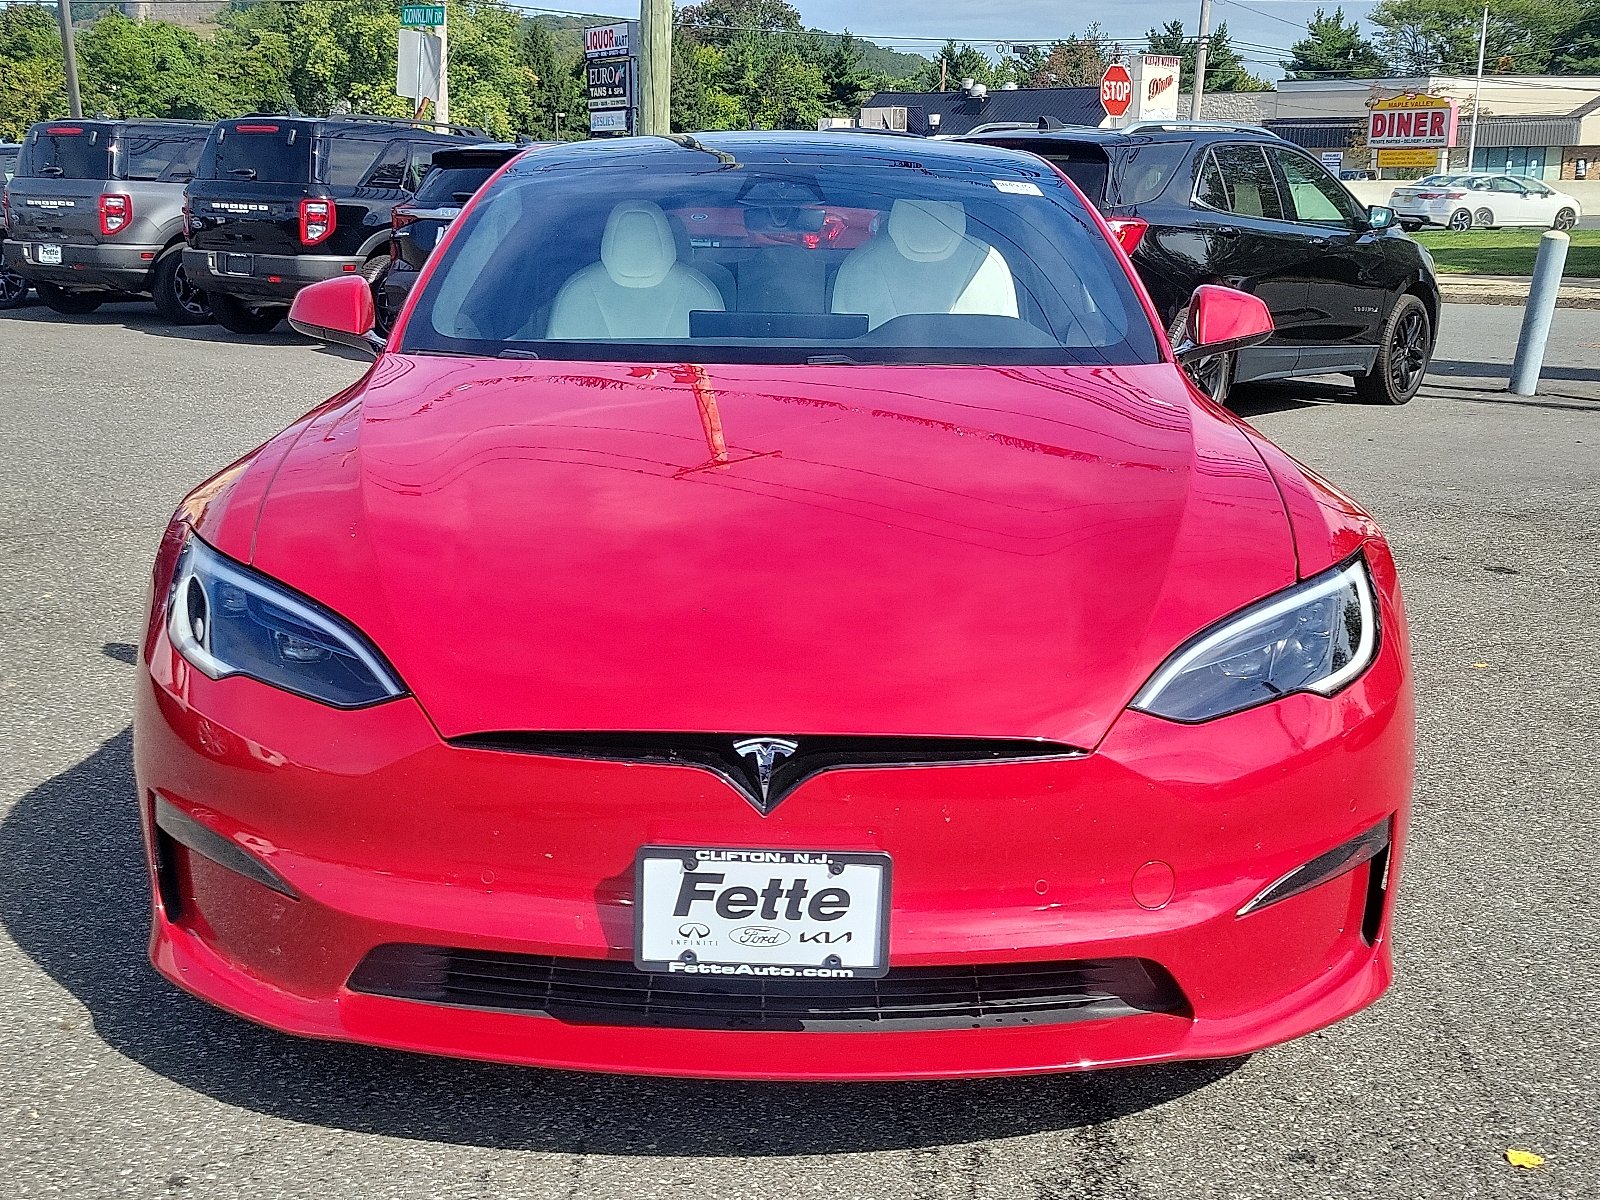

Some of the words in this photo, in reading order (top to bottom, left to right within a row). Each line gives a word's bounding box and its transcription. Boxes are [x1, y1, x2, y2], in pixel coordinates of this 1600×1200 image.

[403, 8, 433, 24] CONKLIN
[434, 11, 443, 24] DR
[586, 30, 614, 50] LIQUOR
[615, 34, 628, 47] MART
[589, 66, 615, 85] EURO
[590, 86, 607, 98] TANS
[613, 87, 624, 95] SPA
[1104, 81, 1130, 101] STOP
[1372, 112, 1445, 137] DINER
[26, 199, 75, 207] BRONCO
[211, 202, 269, 211] BRONCO
[42, 247, 59, 256] Fette
[695, 850, 787, 863] CLIFTON,
[793, 853, 834, 865] N.J.
[672, 871, 851, 922] Fette
[739, 928, 781, 945] Ford
[668, 962, 854, 978] FetteAuto.com
